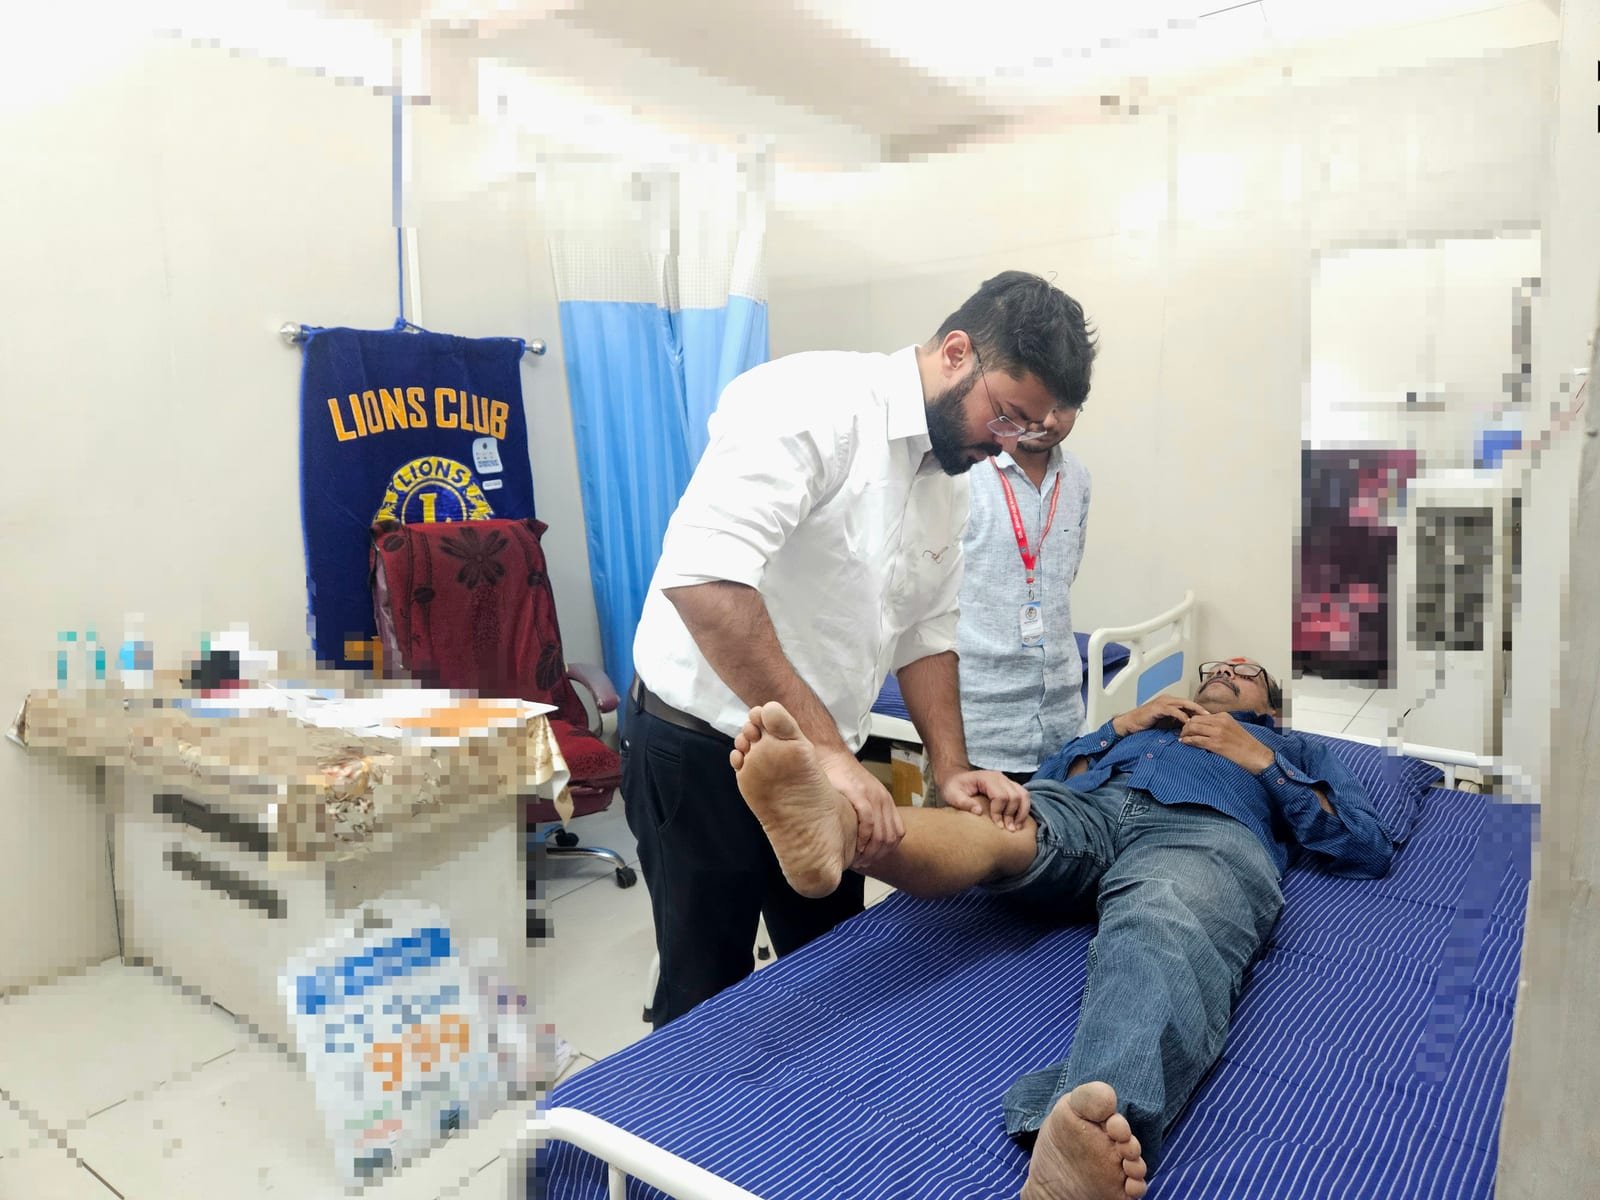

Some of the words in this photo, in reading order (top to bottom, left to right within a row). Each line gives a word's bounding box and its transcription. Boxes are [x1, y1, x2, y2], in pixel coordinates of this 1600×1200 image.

[327, 387, 428, 442] LIONS
[434, 387, 509, 440] CLUB
[398, 460, 467, 488] LIONS
